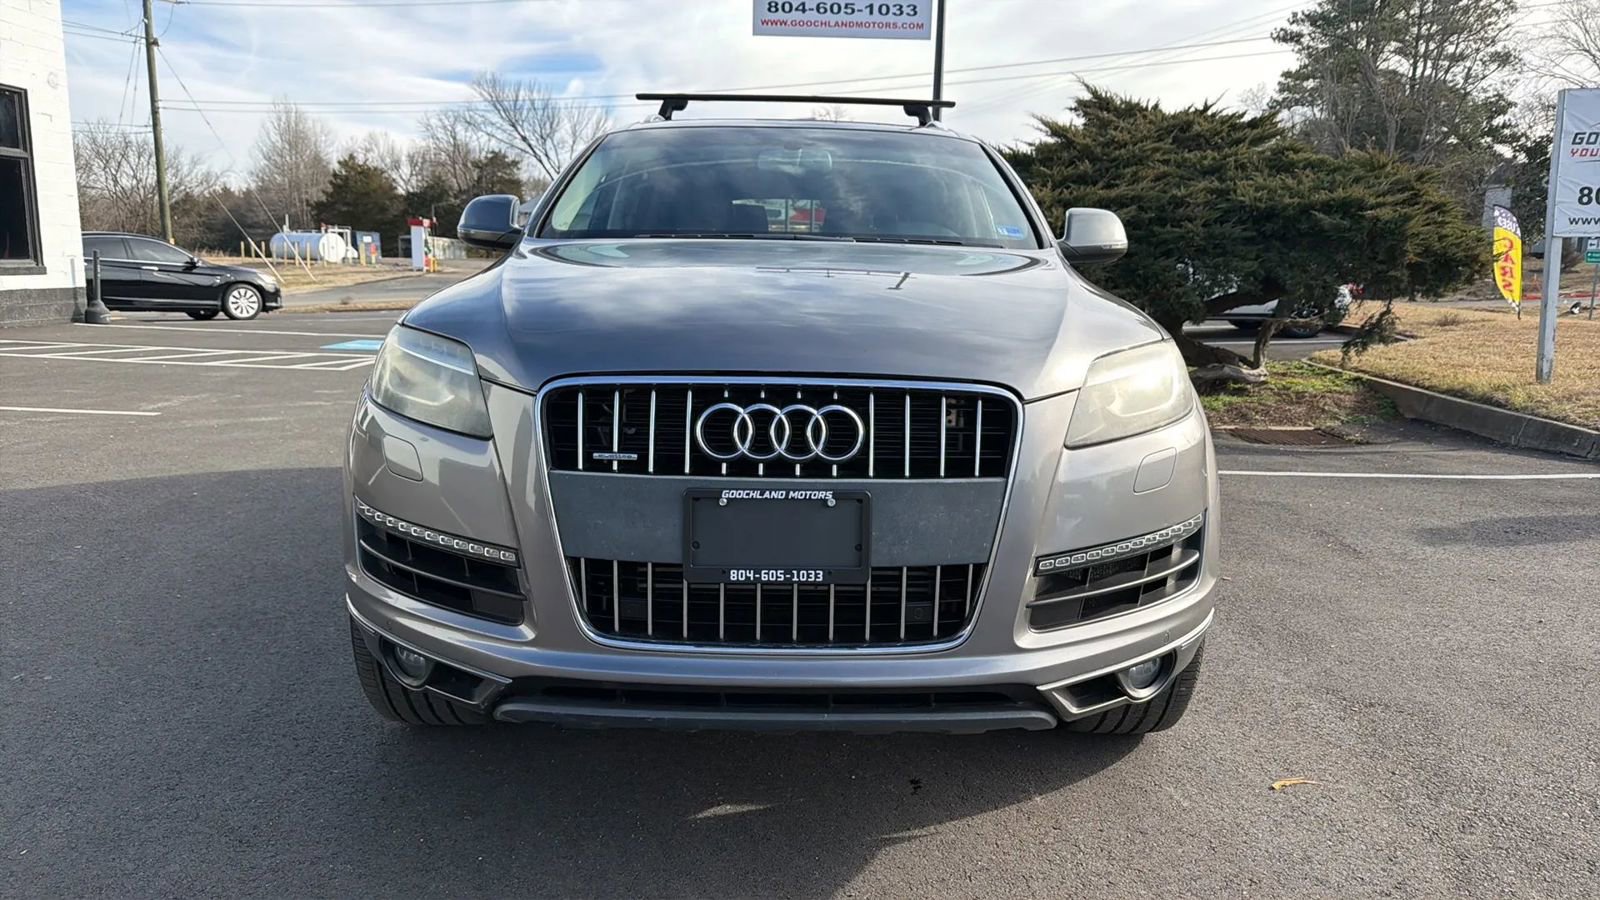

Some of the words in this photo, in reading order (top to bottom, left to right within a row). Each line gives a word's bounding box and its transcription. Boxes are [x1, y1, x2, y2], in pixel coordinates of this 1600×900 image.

[767, 1, 919, 17] 804-605-1033
[761, 19, 924, 30] WWW.GOOCHLANDMOTORS.COM
[1571, 131, 1600, 145] GO
[1570, 148, 1600, 157] YOU
[722, 490, 786, 499] GOOCHLAND
[788, 491, 833, 500] MOTORS
[730, 570, 823, 581] 804-605-1033
